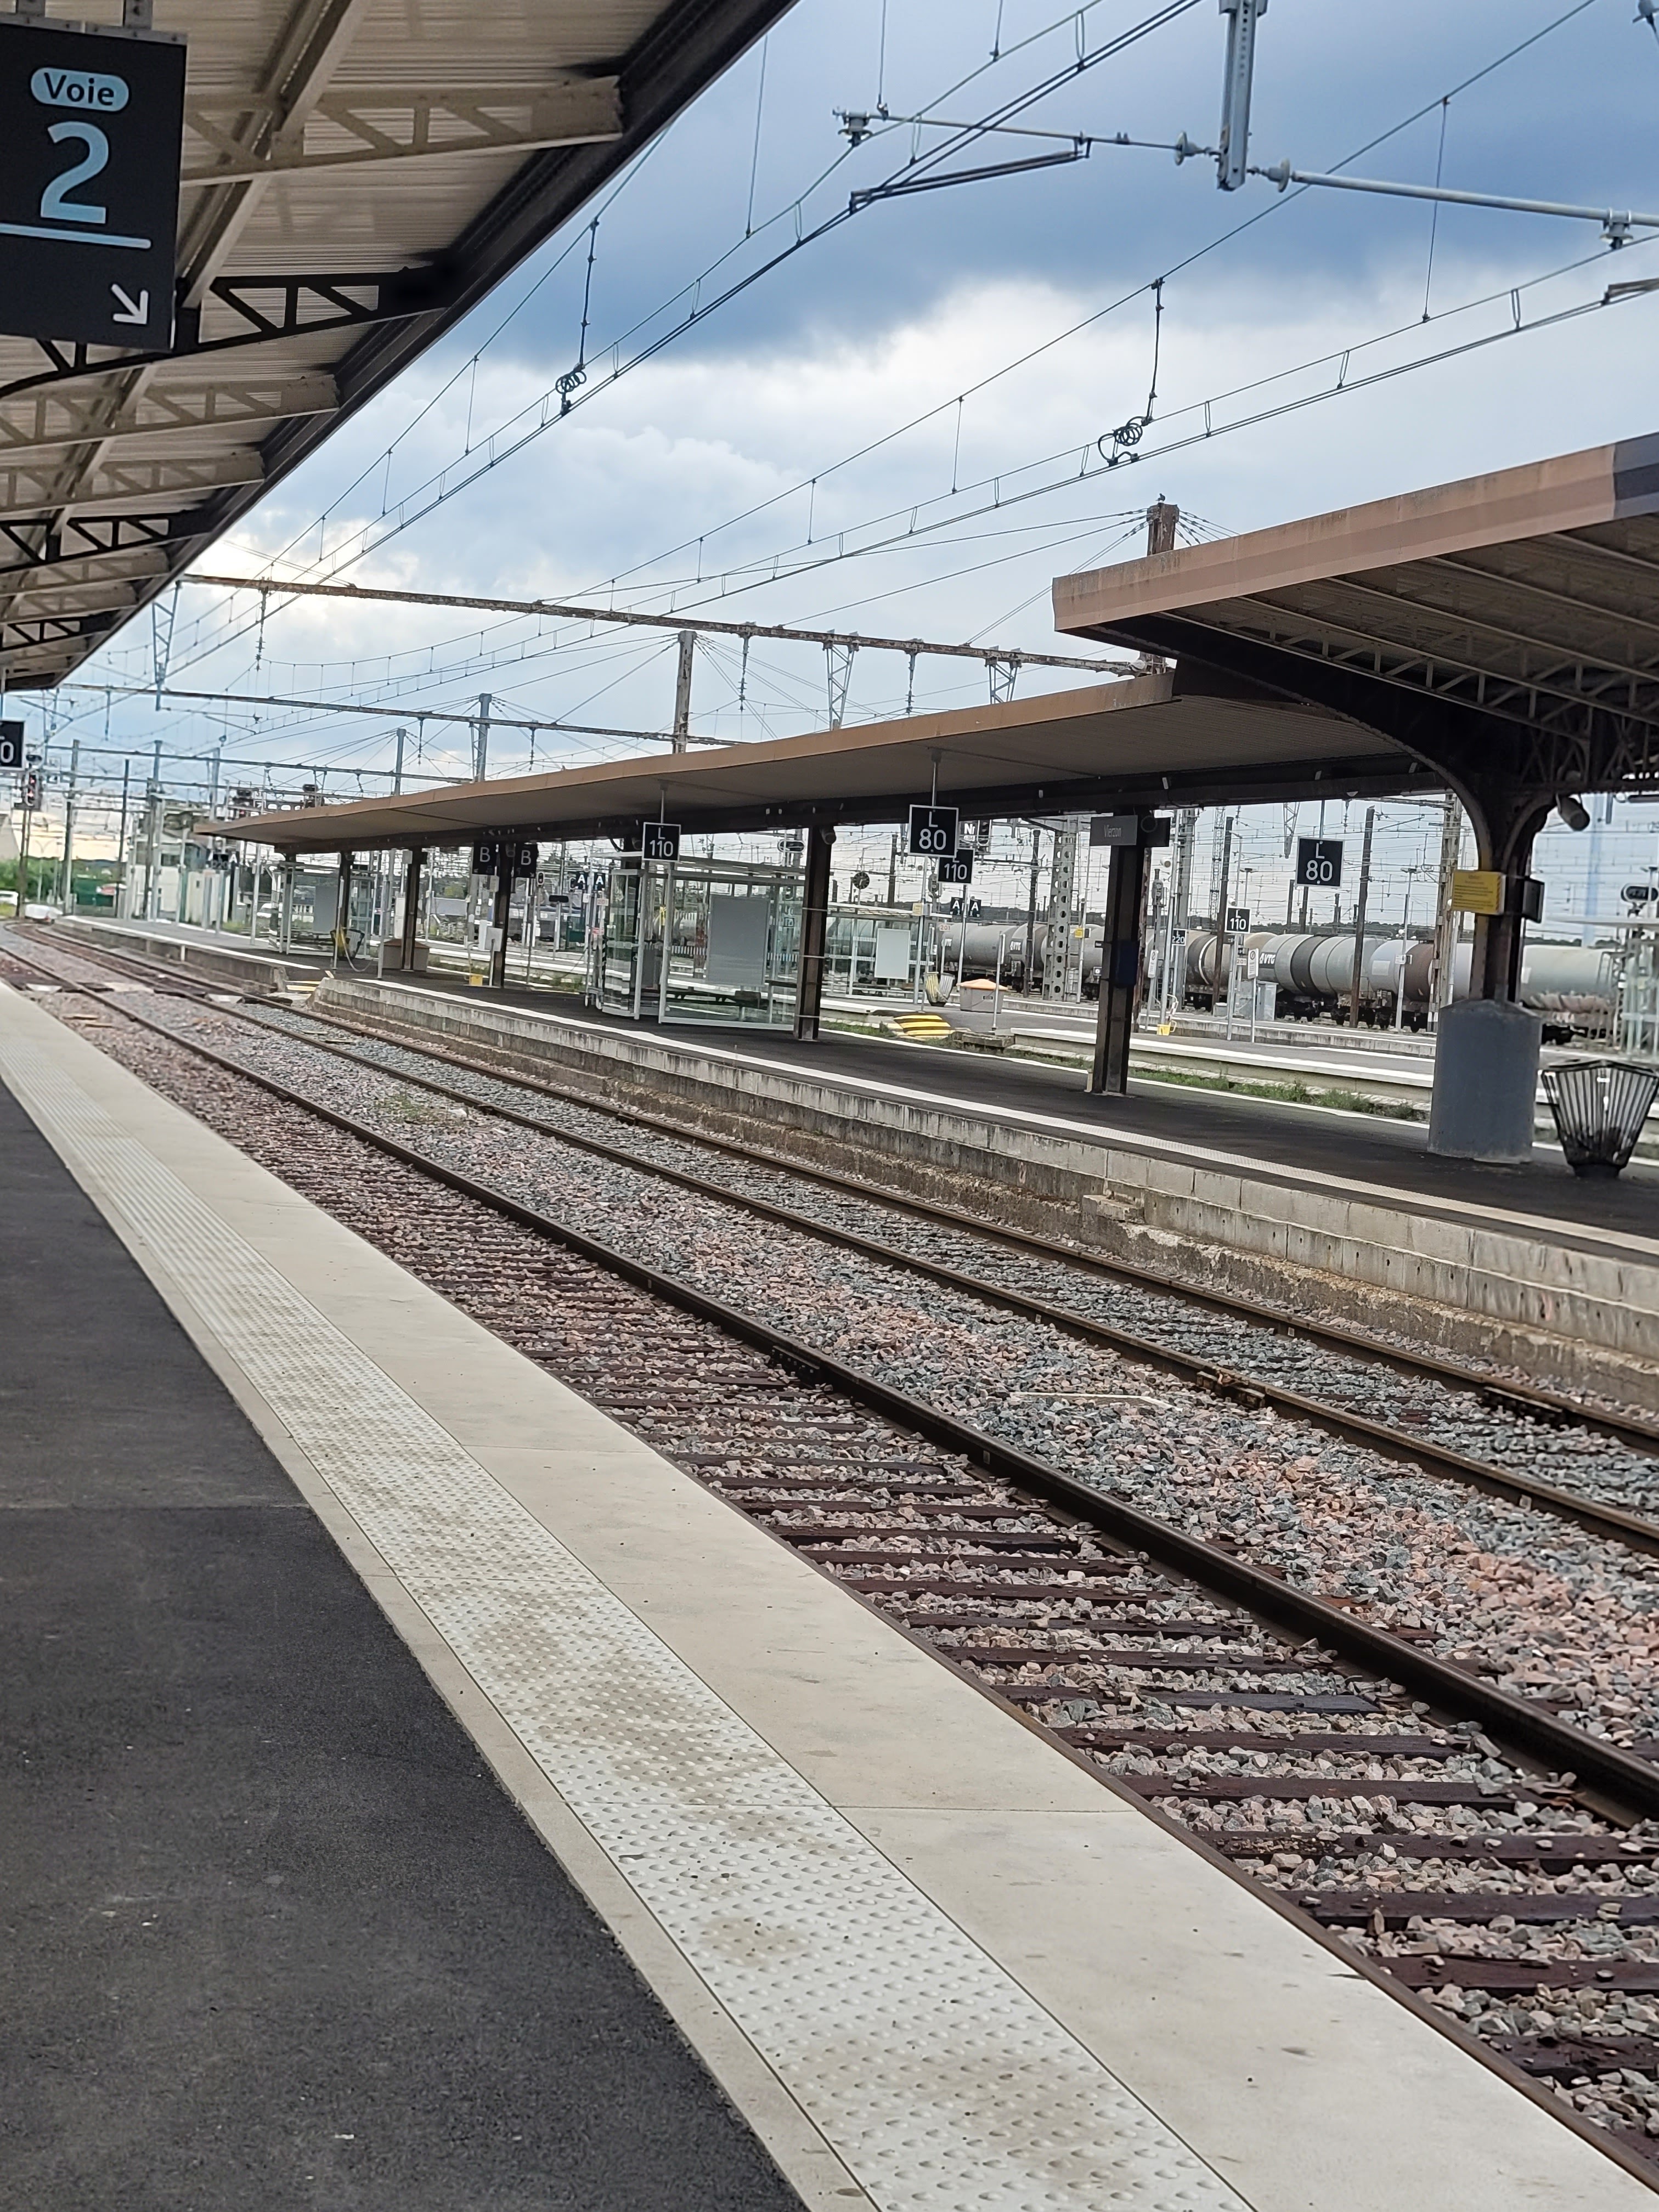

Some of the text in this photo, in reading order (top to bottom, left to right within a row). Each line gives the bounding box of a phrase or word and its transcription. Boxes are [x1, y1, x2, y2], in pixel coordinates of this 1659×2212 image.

[44, 72, 115, 106] Voie
[40, 121, 109, 224] 2
[928, 811, 938, 827] L
[658, 827, 665, 839] L
[964, 823, 975, 834] Nr
[919, 828, 946, 850] 80
[479, 847, 490, 862] B
[650, 840, 674, 857] 110
[1316, 843, 1325, 859] L
[521, 850, 532, 865] B
[577, 874, 586, 883] A
[944, 863, 967, 882] 110
[1306, 860, 1333, 882] 80
[595, 876, 604, 885] A
[952, 900, 960, 909] A
[970, 902, 979, 911] A
[1235, 909, 1242, 918] L
[1230, 918, 1246, 930] 110
[1259, 952, 1276, 964] AVTG
